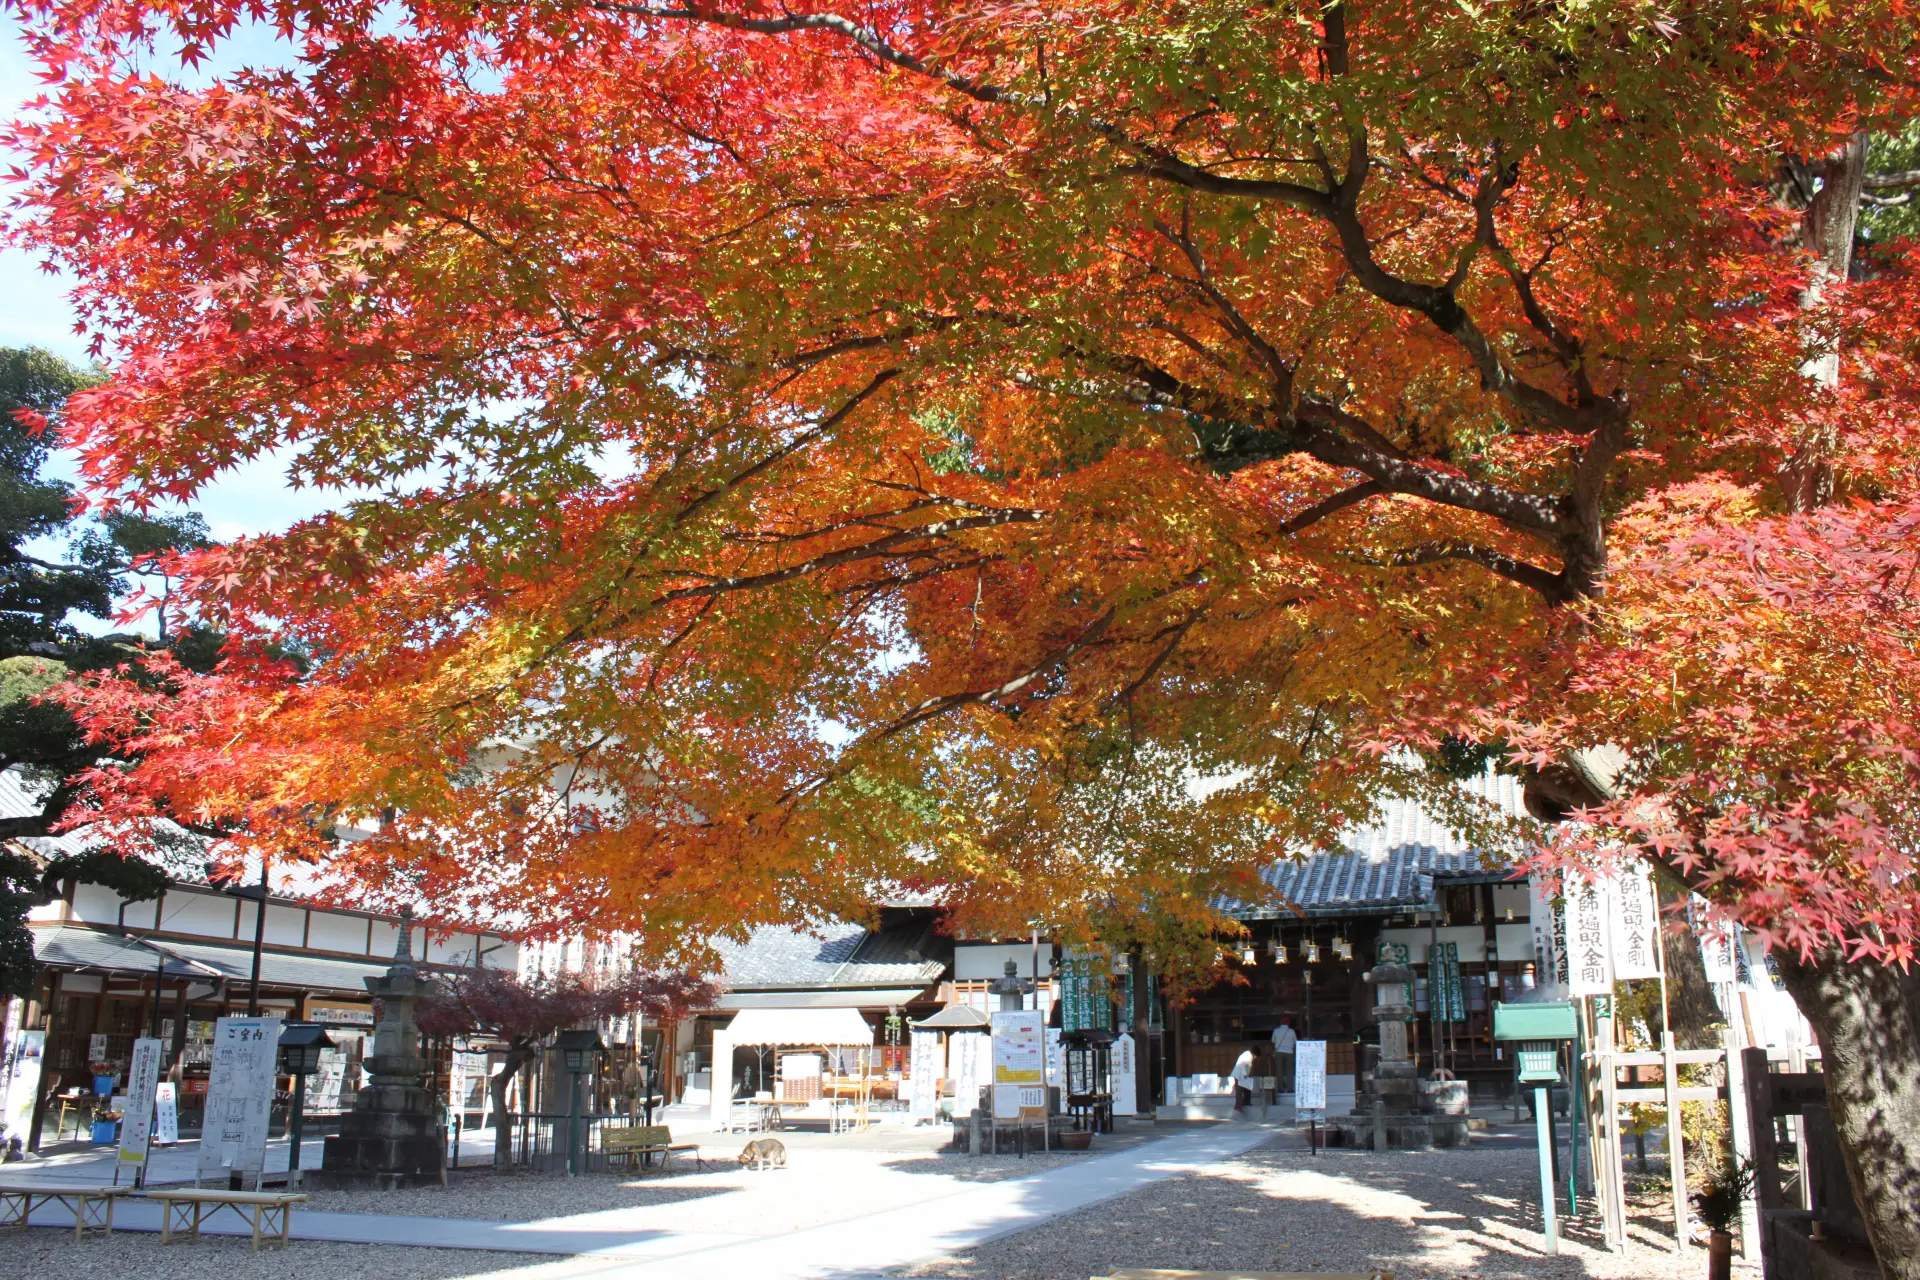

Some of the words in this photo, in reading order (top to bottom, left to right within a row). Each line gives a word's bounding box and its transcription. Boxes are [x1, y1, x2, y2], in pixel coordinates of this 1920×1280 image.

[228, 1028, 263, 1042] ご案内
[162, 1089, 171, 1101] 花
